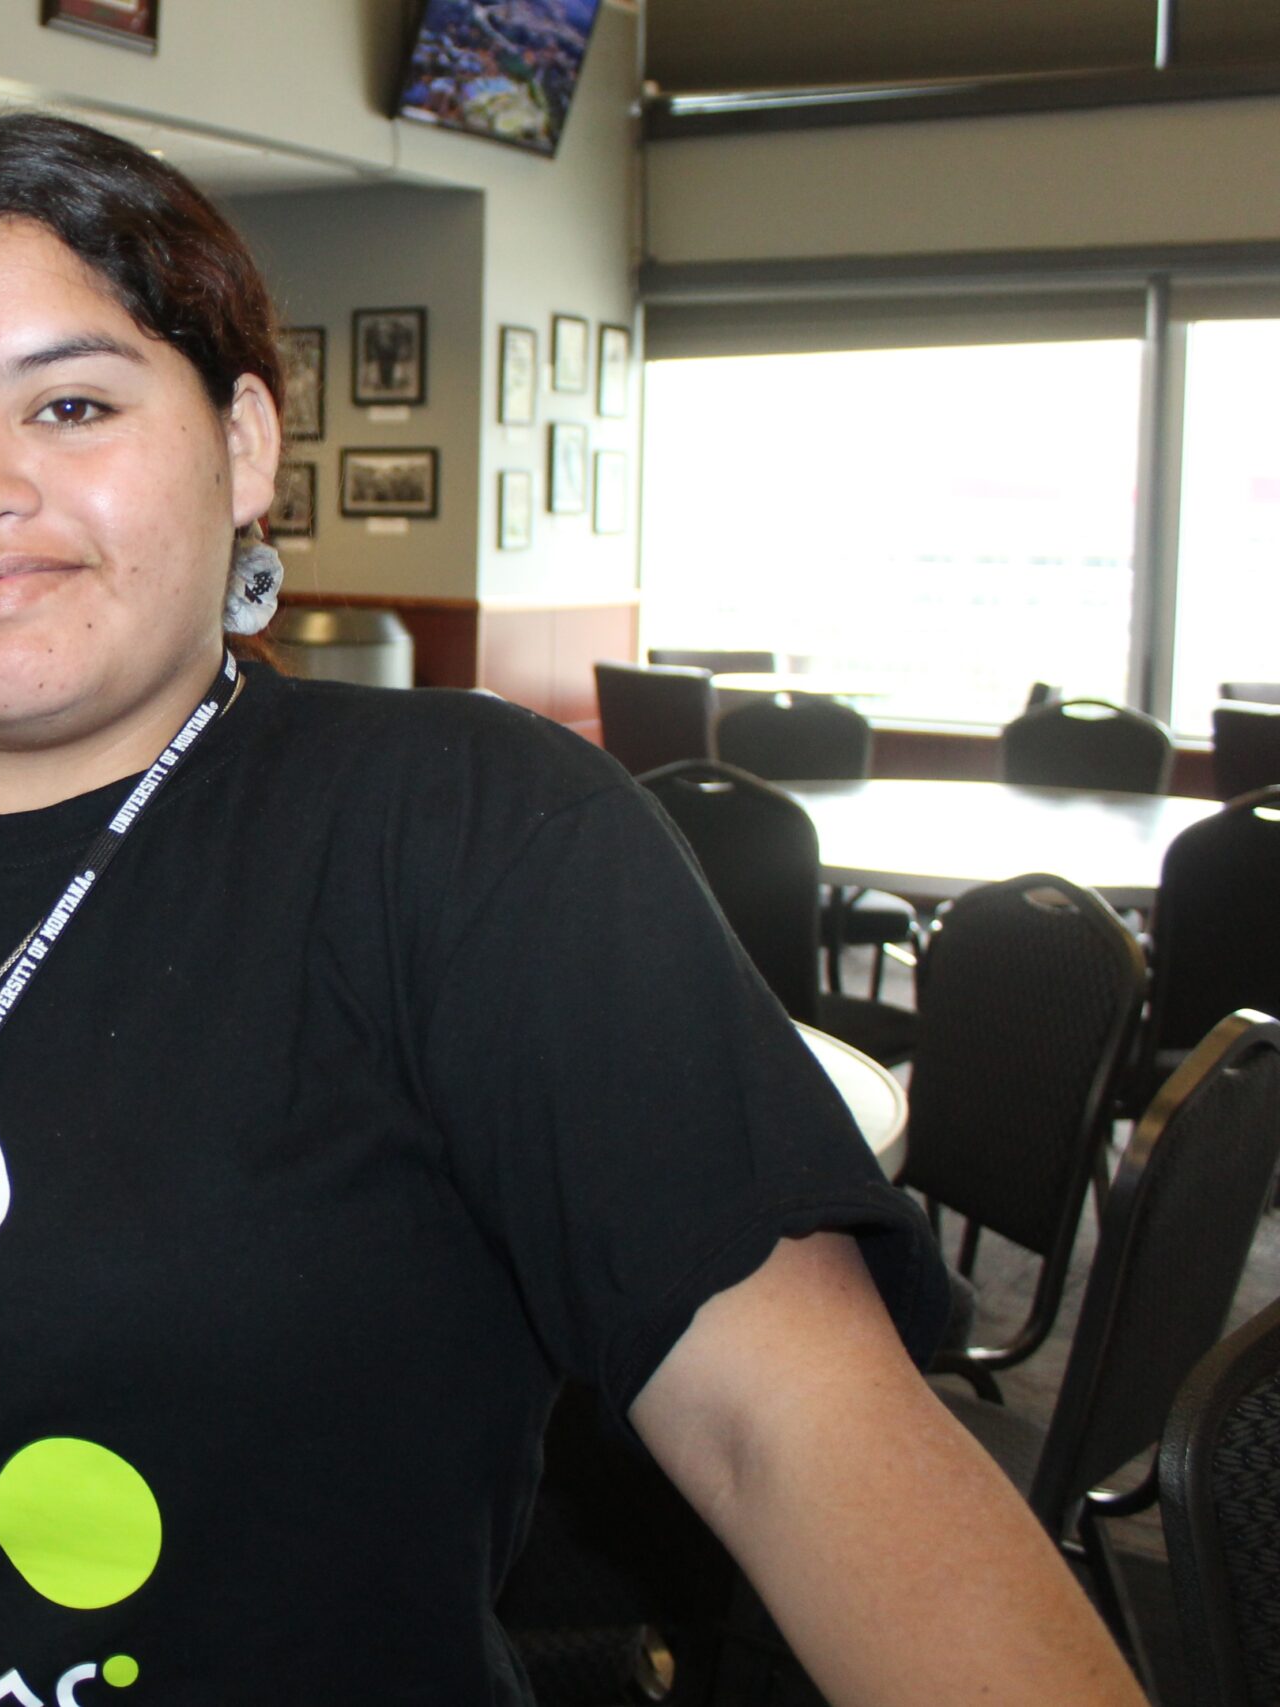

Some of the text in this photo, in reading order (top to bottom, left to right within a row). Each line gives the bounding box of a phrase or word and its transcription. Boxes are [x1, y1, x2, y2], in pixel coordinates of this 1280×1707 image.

[108, 762, 169, 834] UNIVERSITY
[159, 749, 180, 767] OF
[27, 936, 50, 960] OF
